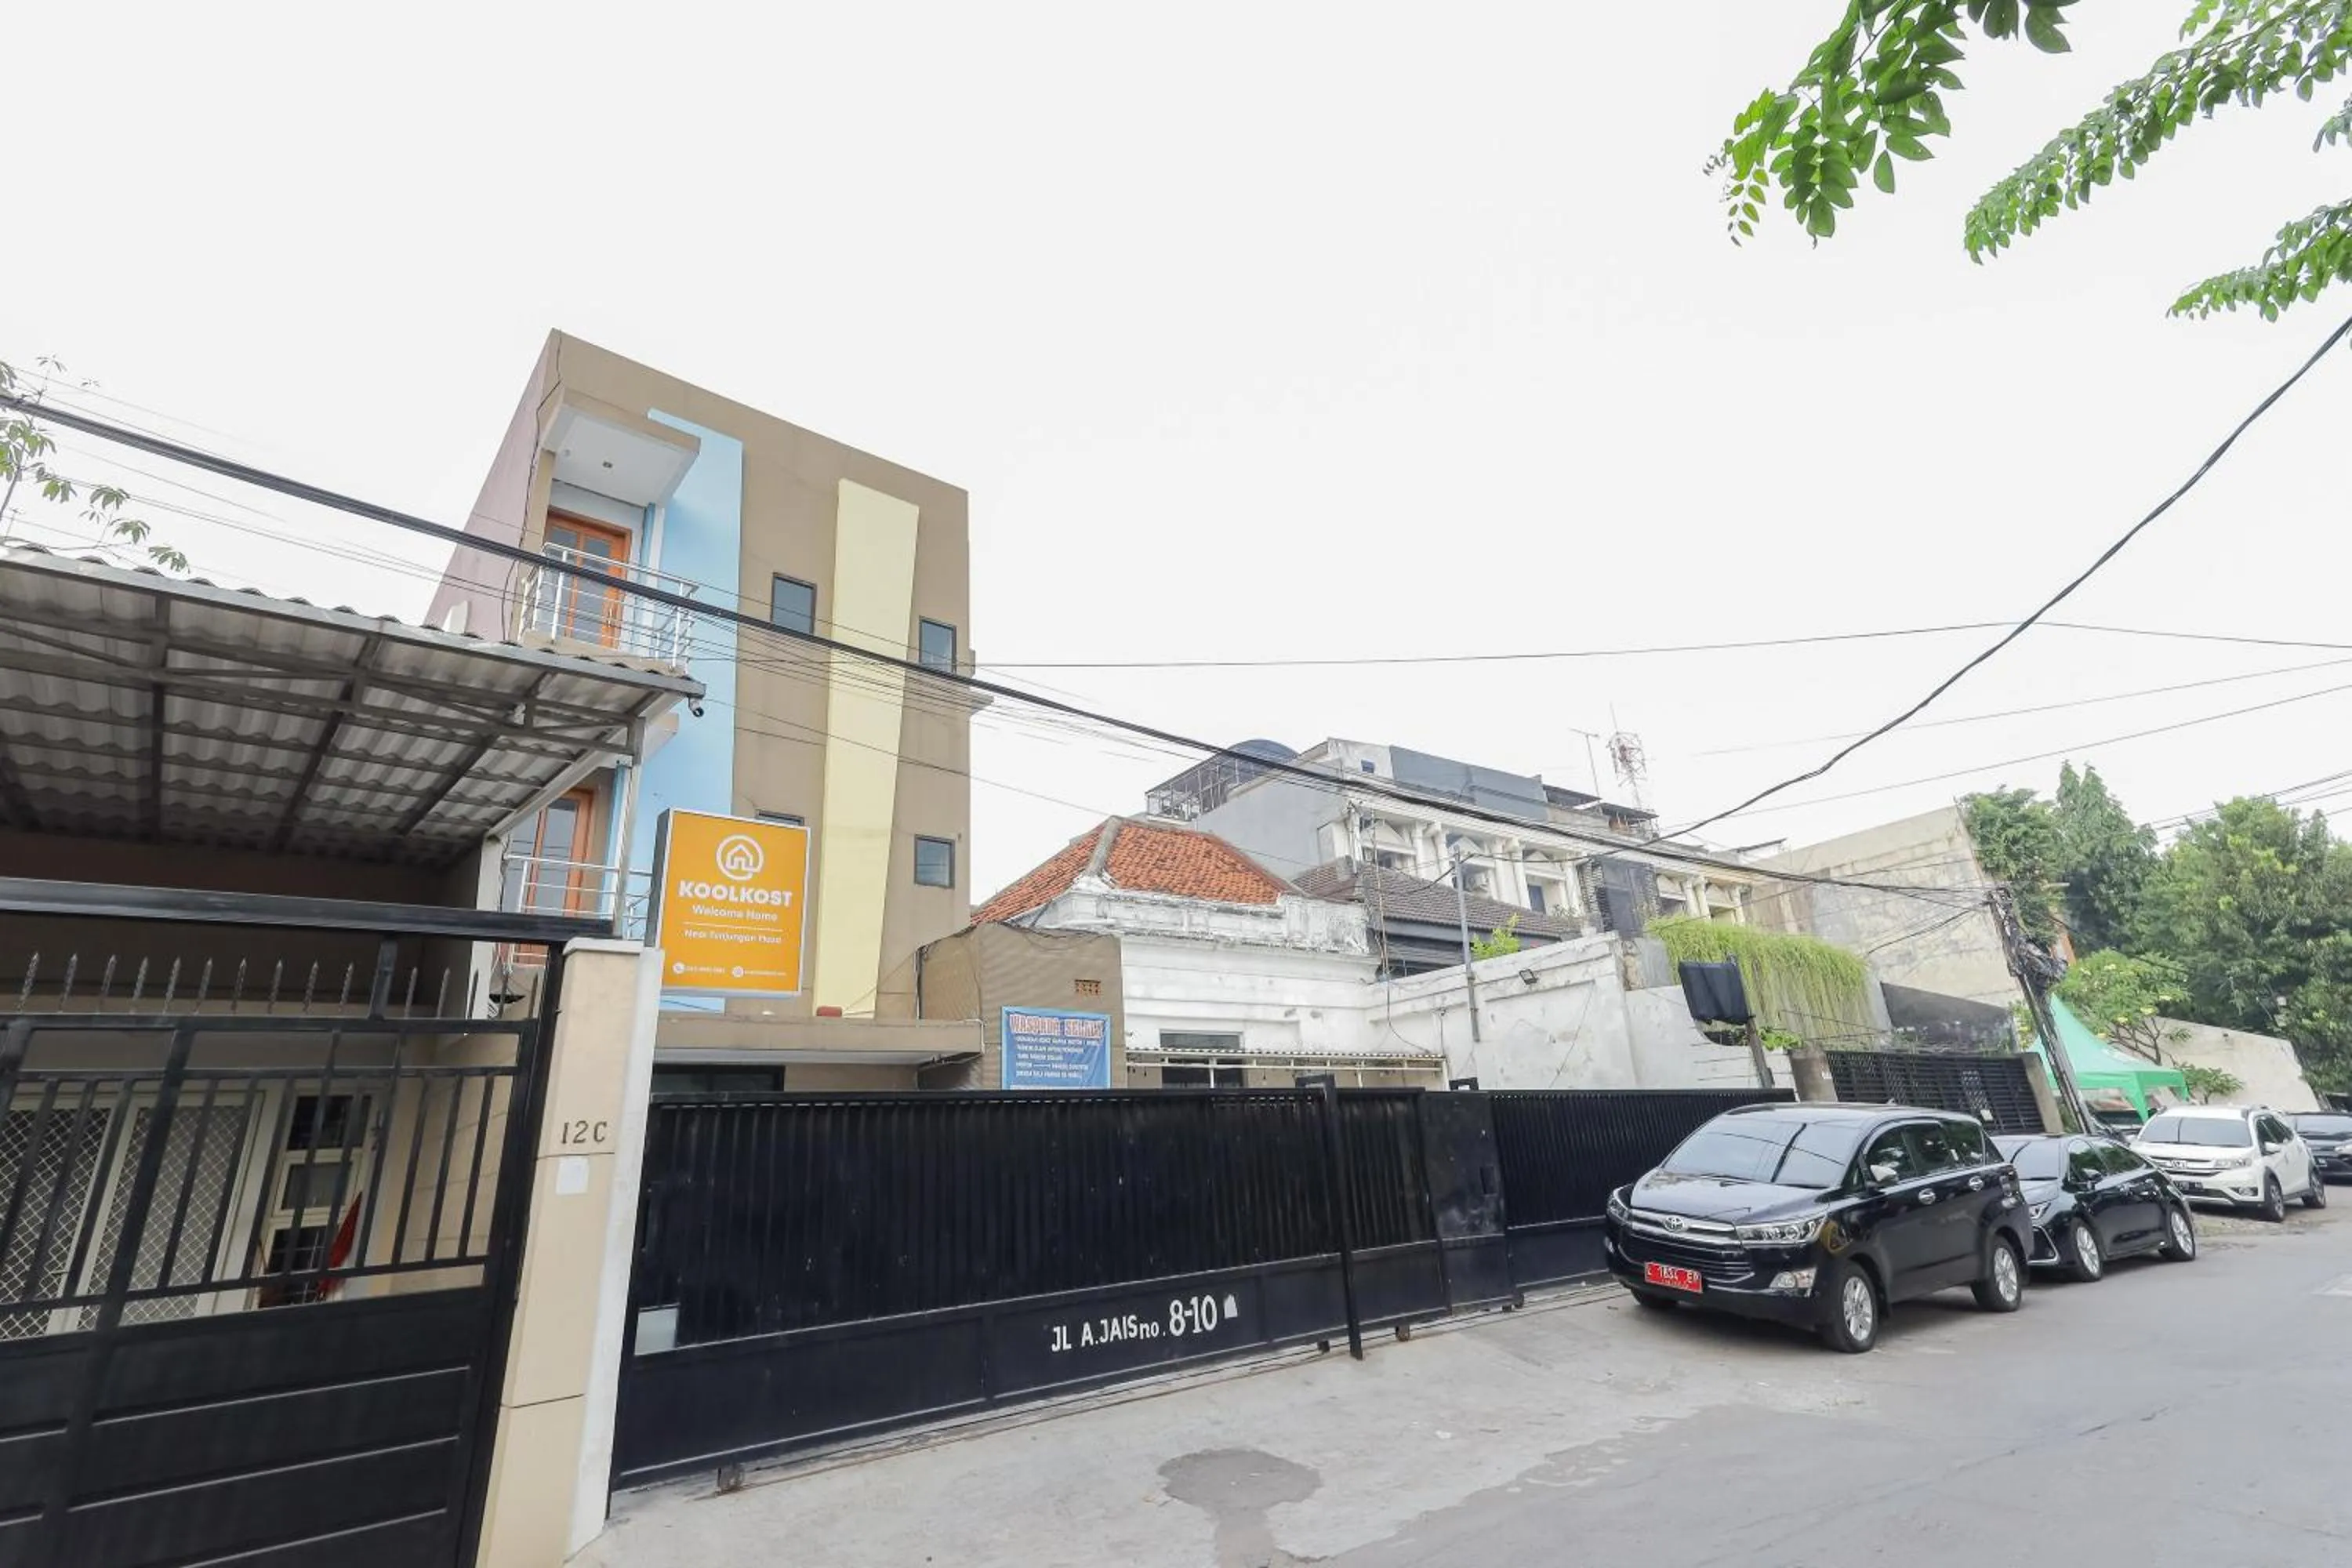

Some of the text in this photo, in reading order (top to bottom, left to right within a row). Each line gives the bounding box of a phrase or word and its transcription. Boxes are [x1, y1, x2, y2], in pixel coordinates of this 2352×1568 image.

[678, 880, 793, 907] KOOLKOST
[692, 904, 779, 923] Welcome Home
[561, 1120, 608, 1145] 12C
[1051, 1326, 1072, 1352] JL
[1169, 1294, 1217, 1337] 8-10
